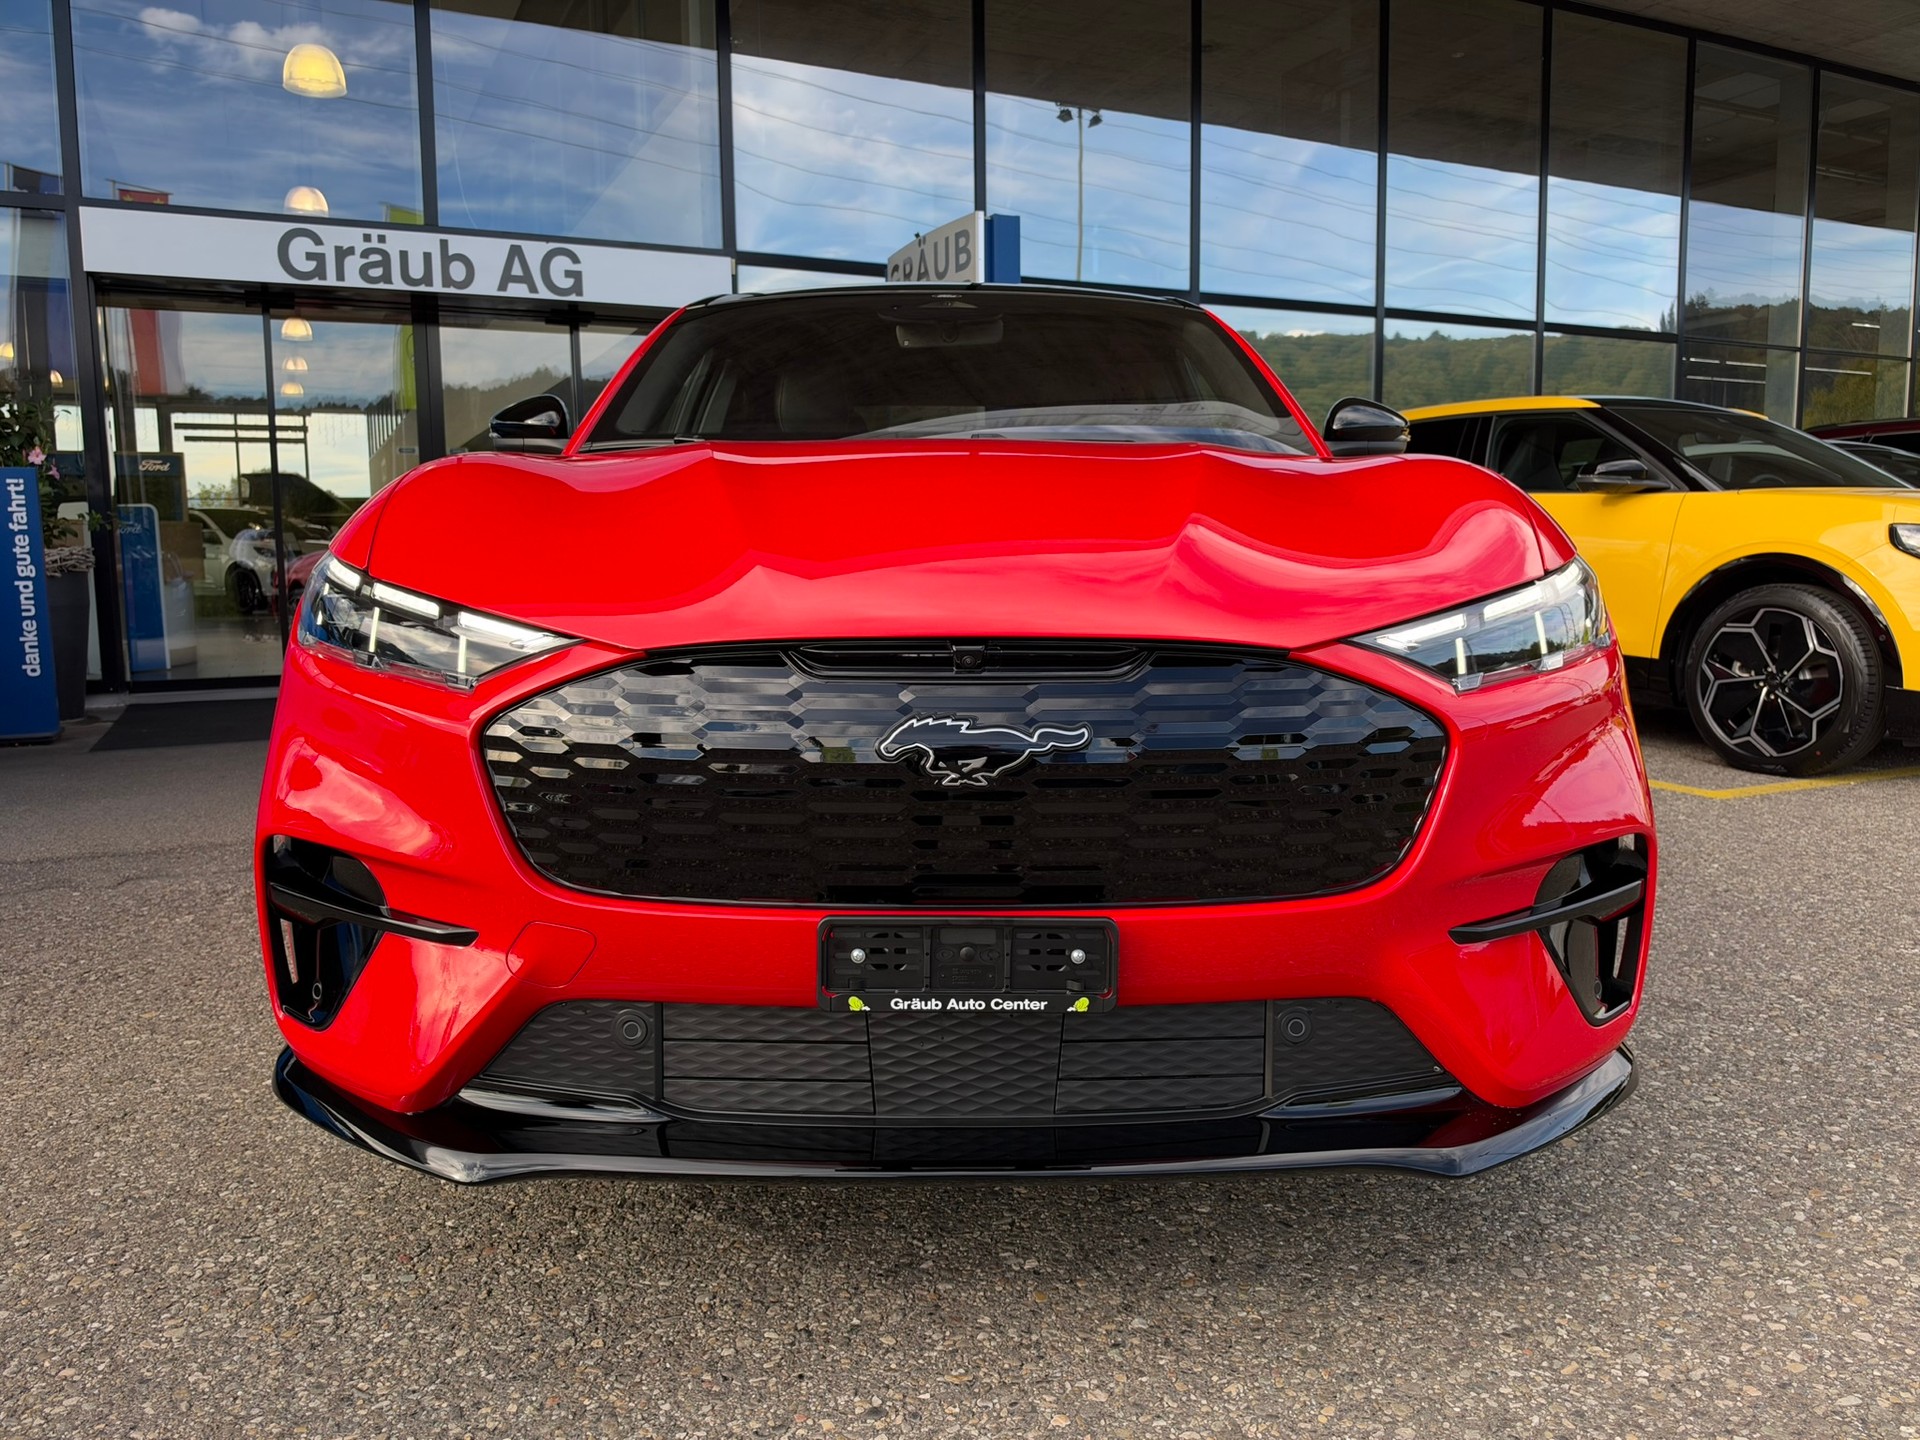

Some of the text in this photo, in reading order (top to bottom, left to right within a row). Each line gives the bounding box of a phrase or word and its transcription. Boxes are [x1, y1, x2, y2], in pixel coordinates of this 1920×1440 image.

[278, 227, 584, 298] Gräub AG
[138, 459, 171, 472] Ford
[6, 478, 41, 677] danke und gute fahrt!
[890, 997, 1048, 1011] Gräub Auto Center
